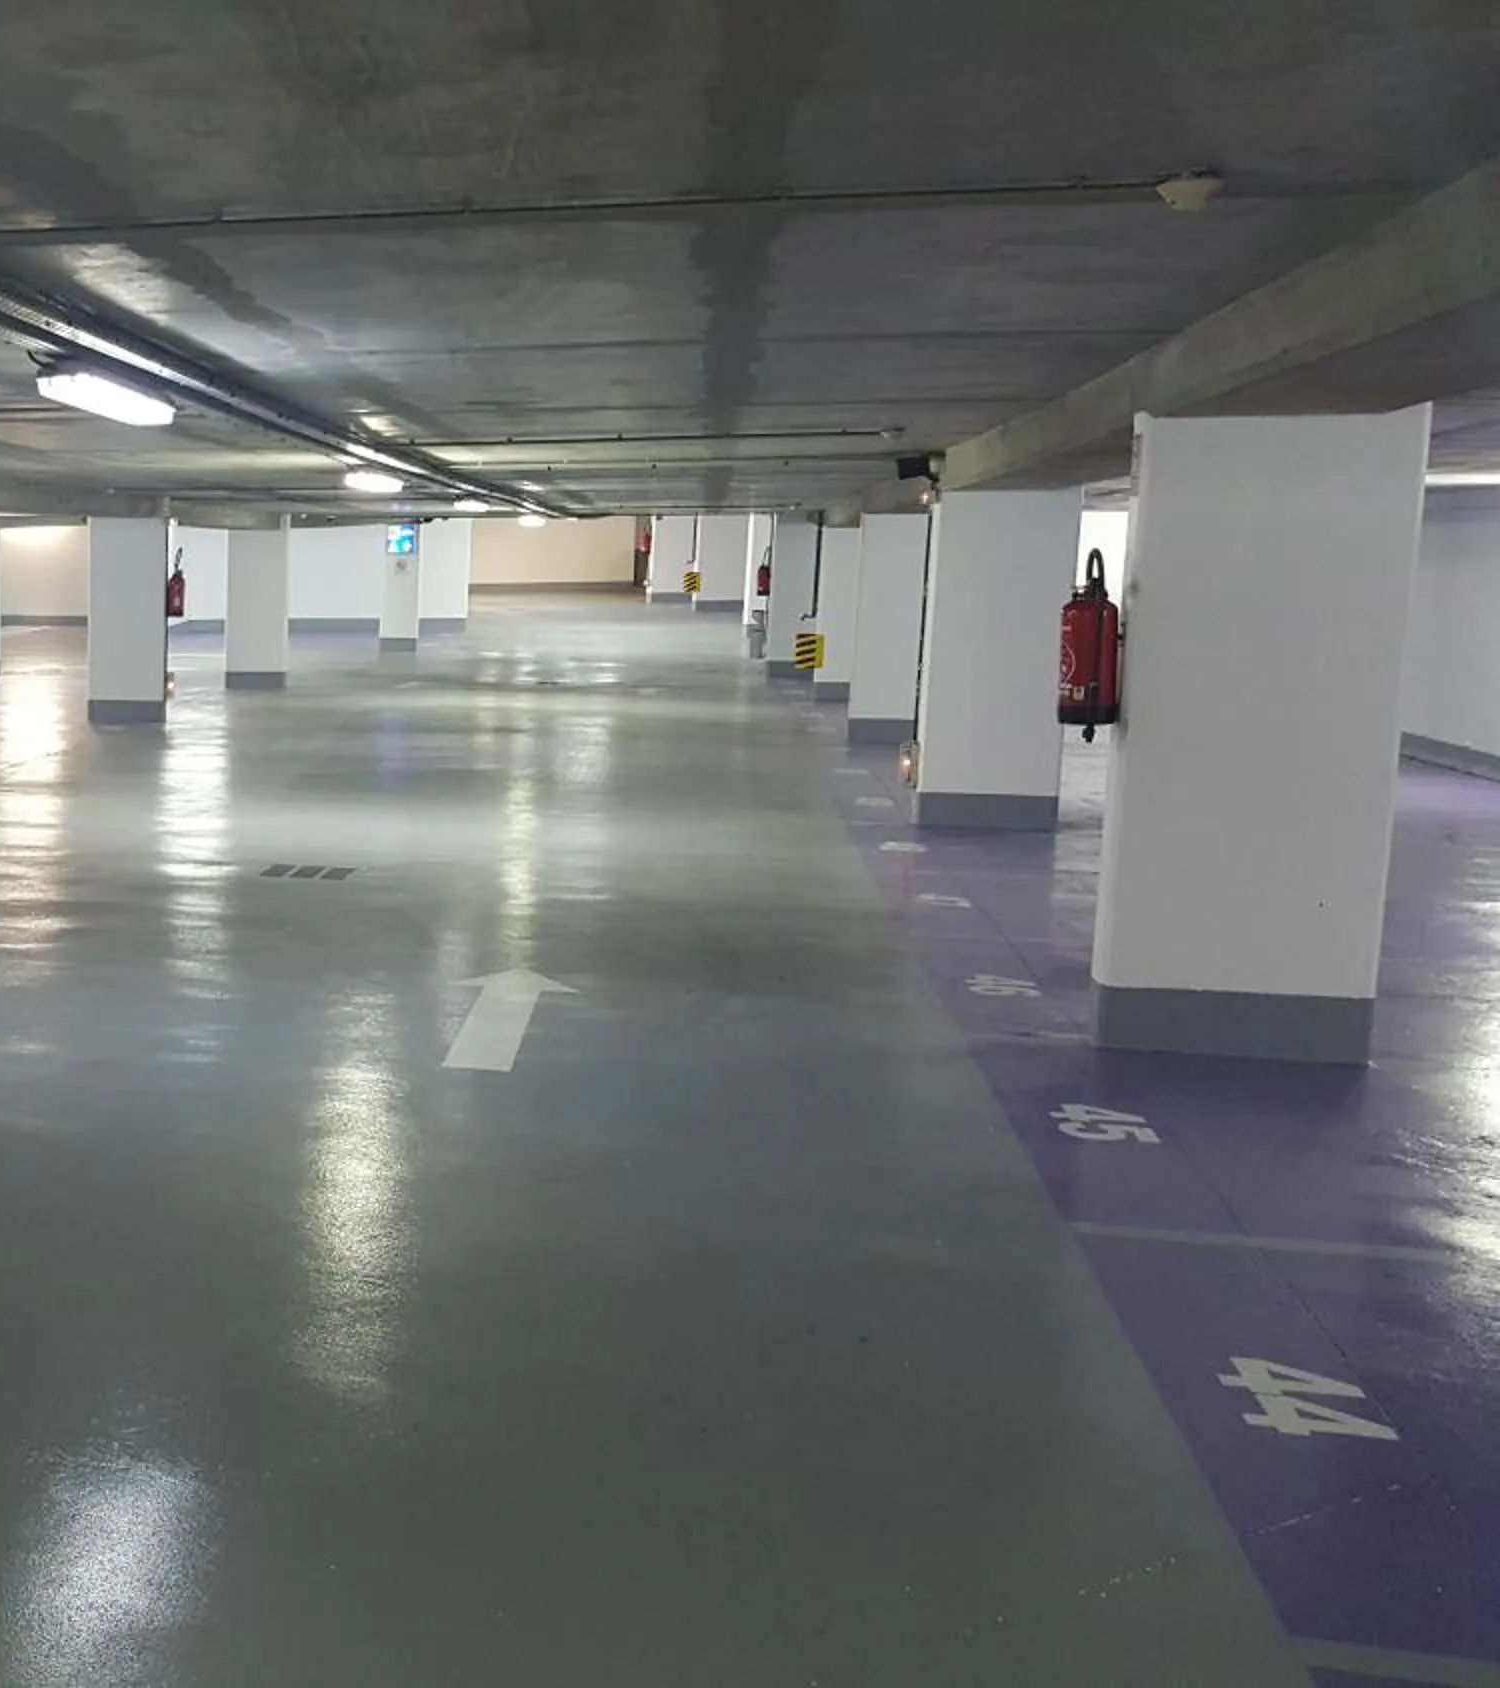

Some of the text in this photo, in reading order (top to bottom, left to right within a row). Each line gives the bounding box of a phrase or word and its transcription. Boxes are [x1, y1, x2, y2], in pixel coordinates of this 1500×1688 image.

[963, 973, 1043, 997] 46
[1048, 1103, 1162, 1145] 45
[1217, 1356, 1401, 1441] 44
